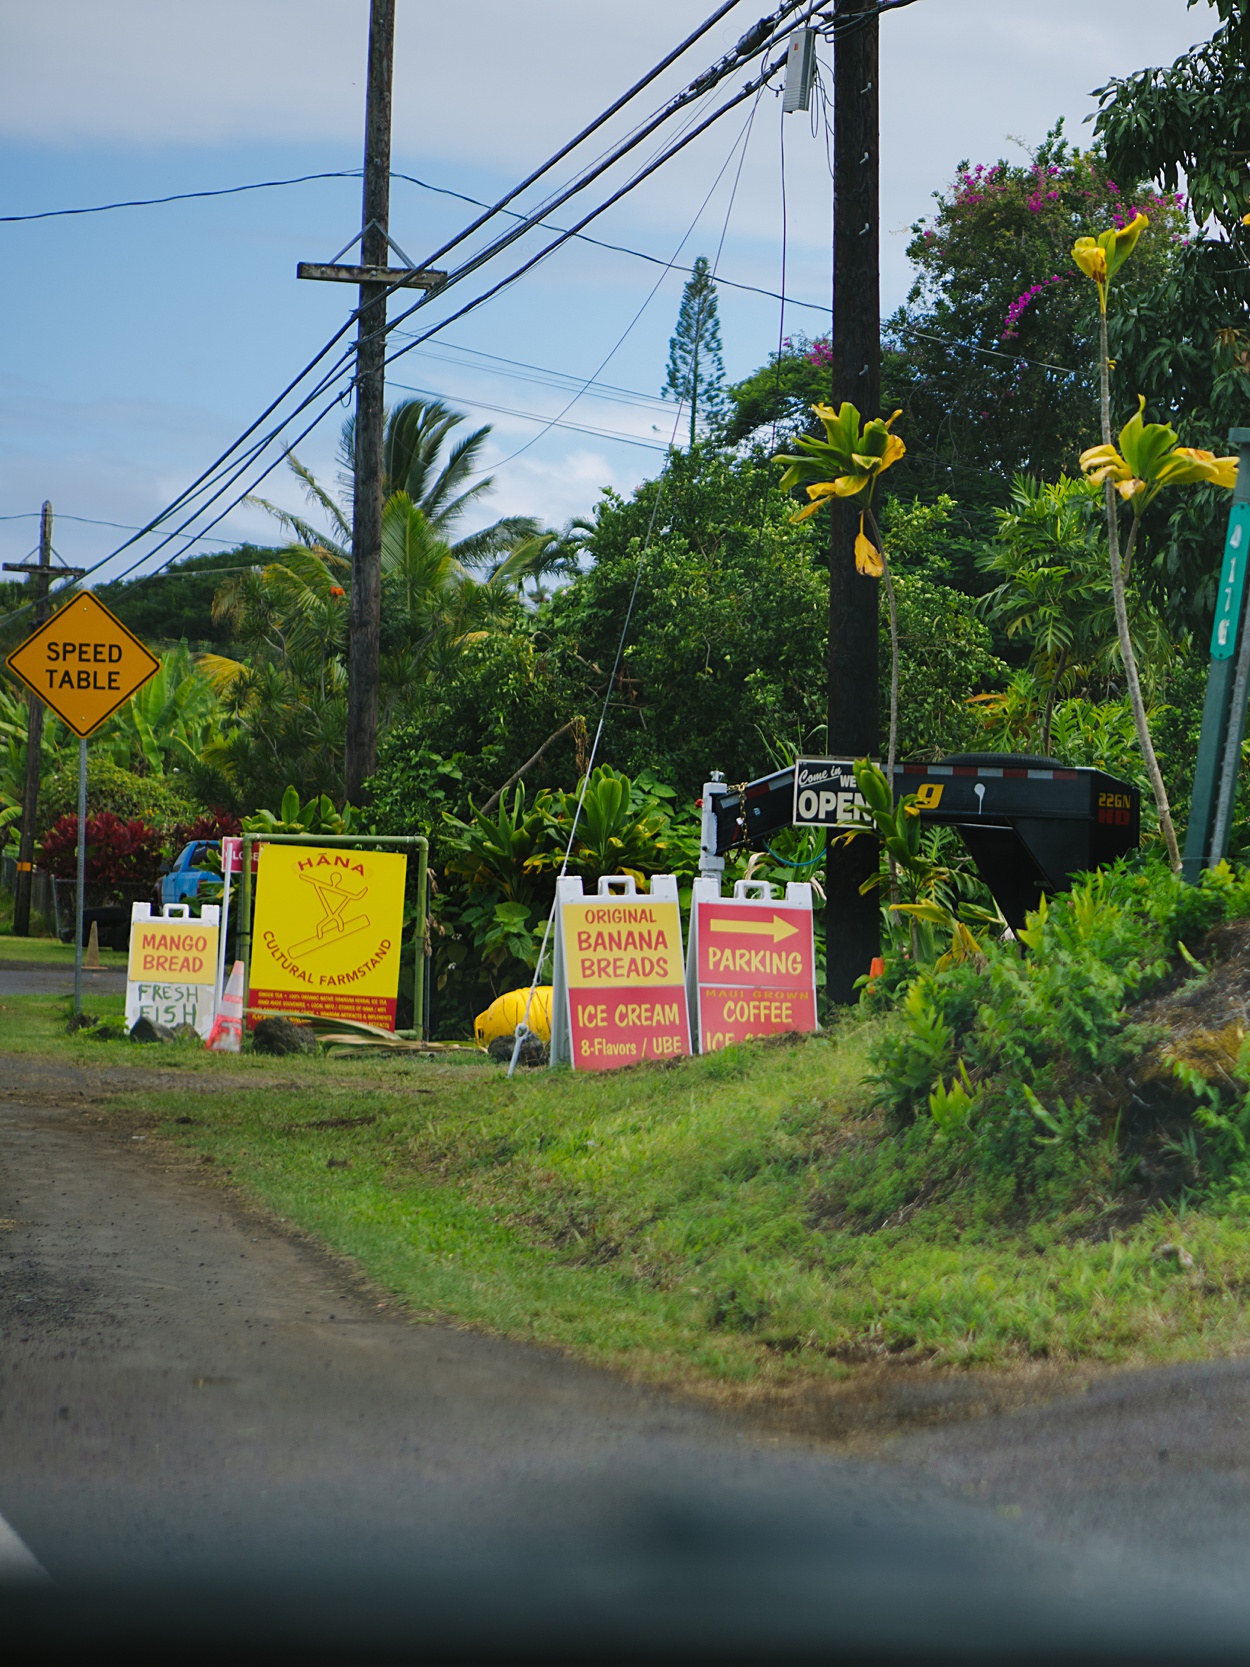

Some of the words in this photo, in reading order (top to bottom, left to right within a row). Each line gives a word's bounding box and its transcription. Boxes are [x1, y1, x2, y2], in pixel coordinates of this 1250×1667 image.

[46, 641, 123, 664] SPEED
[45, 668, 121, 691] TABLE
[798, 768, 829, 790] Come
[830, 764, 843, 781] in
[839, 775, 857, 788] WE
[798, 789, 872, 821] OPEN
[1098, 809, 1131, 826] HD
[298, 852, 366, 878] HĀNA
[585, 908, 657, 924] ORIGINAL
[142, 934, 207, 952] MANGO
[577, 929, 668, 952] BANANA
[143, 954, 203, 973] BREAD
[263, 930, 314, 984] CULTURAL
[319, 938, 392, 986] FARMSTAND
[581, 956, 669, 979] BREADS
[708, 946, 803, 975] PARKING
[138, 984, 198, 1003] FRESH
[706, 989, 744, 998] MAUI
[752, 991, 809, 1000] GROWN
[578, 1004, 608, 1028] ICE
[614, 1002, 679, 1027] CREAM
[723, 1000, 793, 1023] COFFEE
[581, 1038, 636, 1056] 8-Flavors
[653, 1036, 681, 1054] UBE
